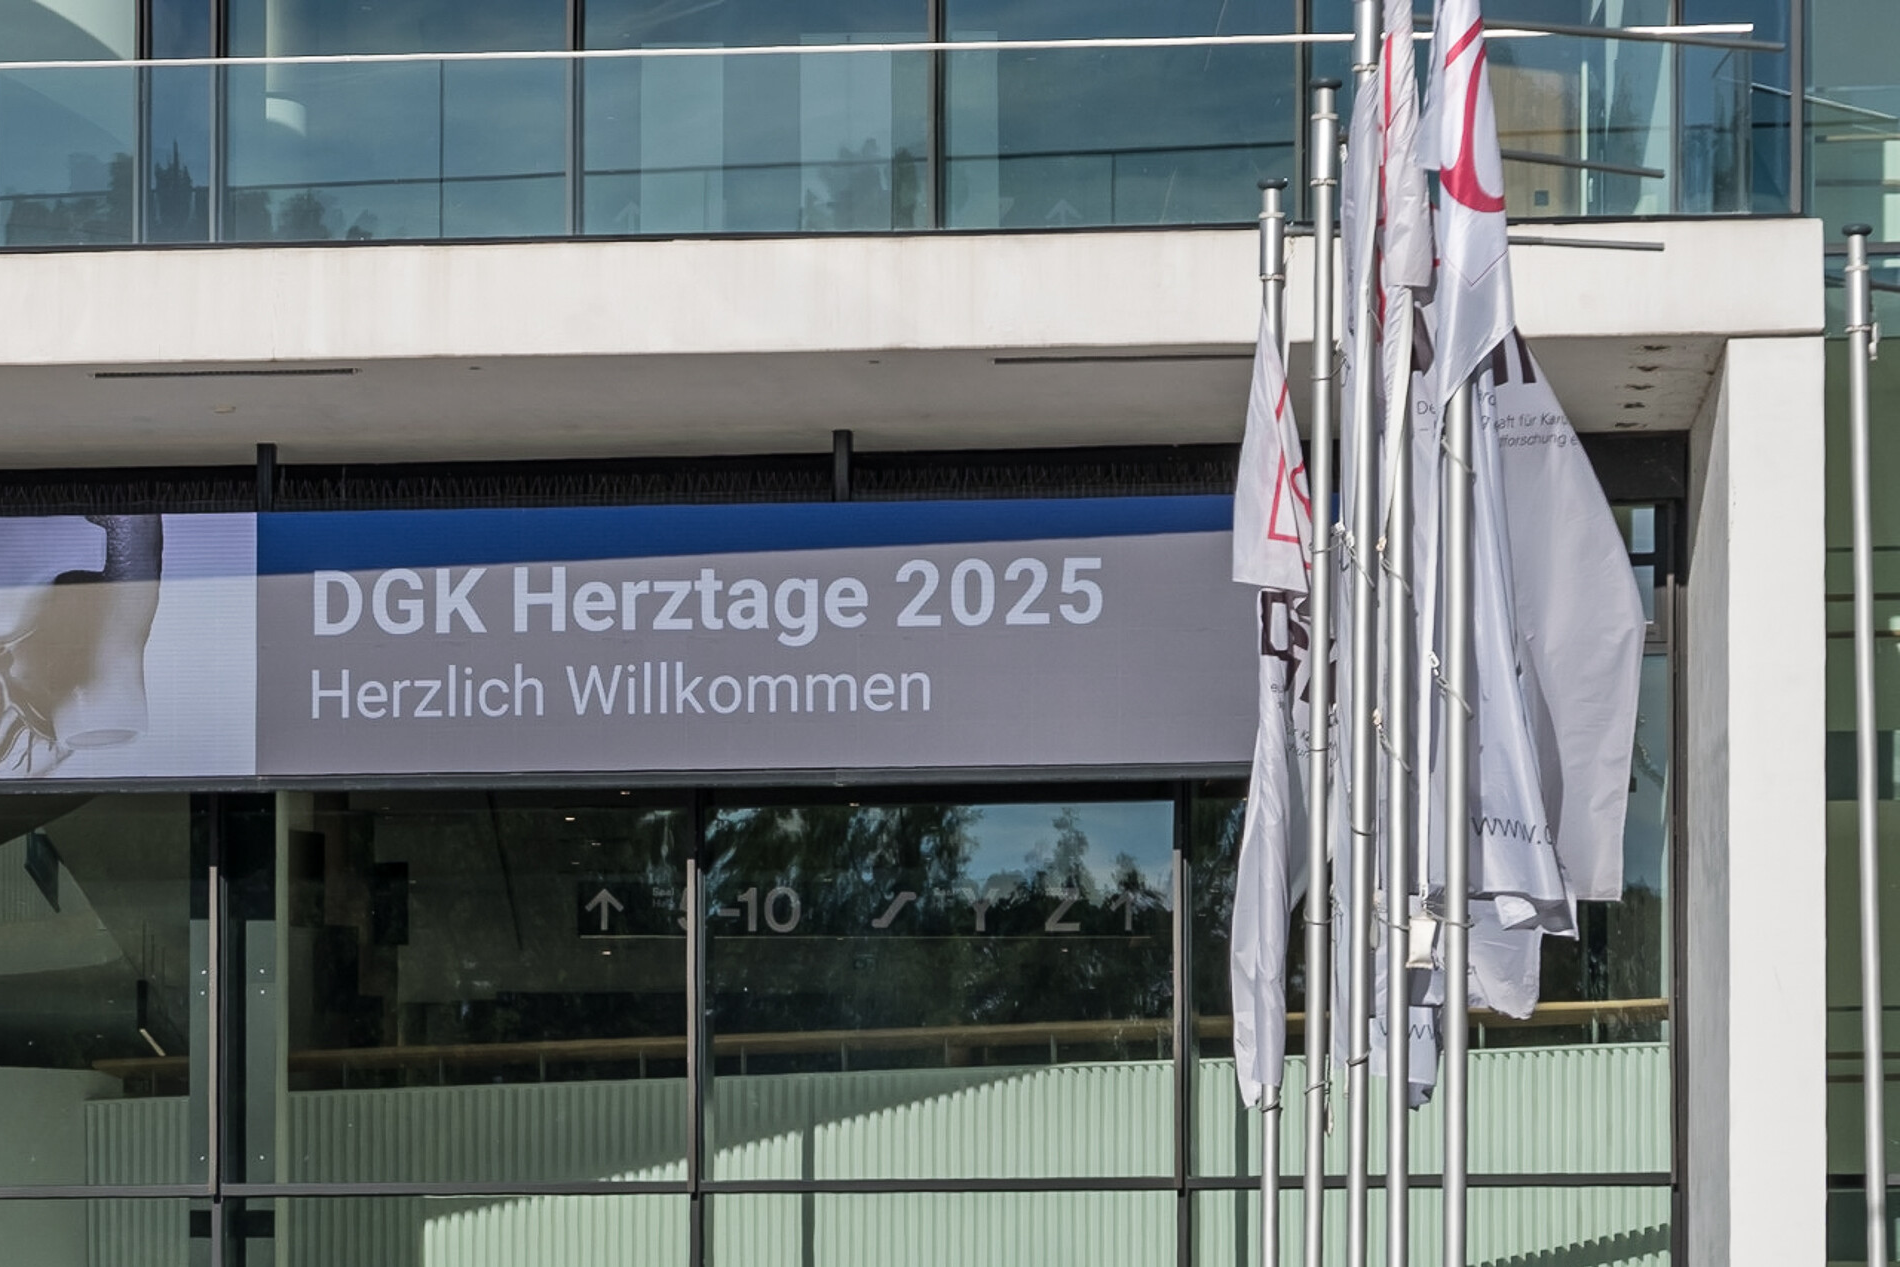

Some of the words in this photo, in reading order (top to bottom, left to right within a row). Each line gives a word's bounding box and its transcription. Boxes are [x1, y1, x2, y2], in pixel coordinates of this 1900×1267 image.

[313, 567, 488, 636] DGK
[513, 565, 869, 647] Herztage
[895, 556, 1104, 628] 2025
[311, 662, 545, 720] Herzlich
[565, 660, 932, 716] Willkommen
